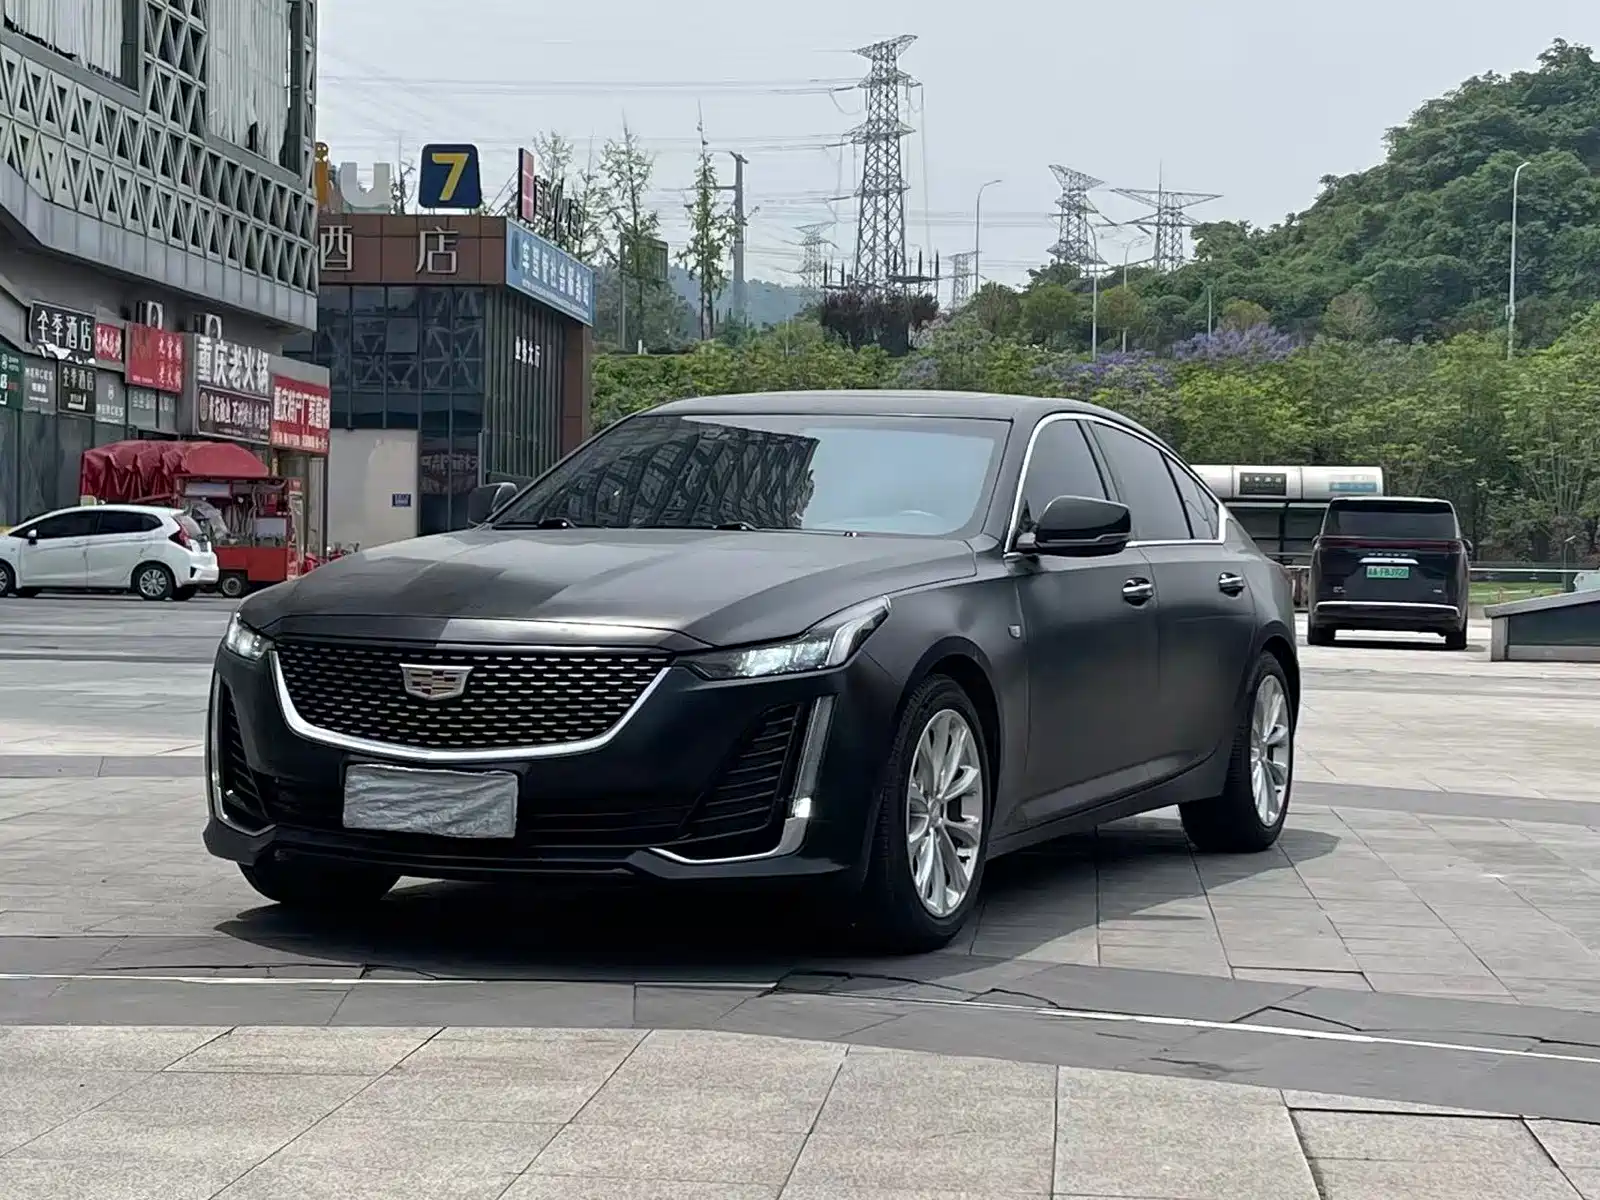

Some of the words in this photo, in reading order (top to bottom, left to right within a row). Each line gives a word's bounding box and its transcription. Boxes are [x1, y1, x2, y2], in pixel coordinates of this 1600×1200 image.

[431, 153, 469, 201] 7
[37, 310, 92, 352] 全季酒店
[63, 367, 94, 391] 全季酒店
[198, 335, 269, 396] 重庆老火锅
